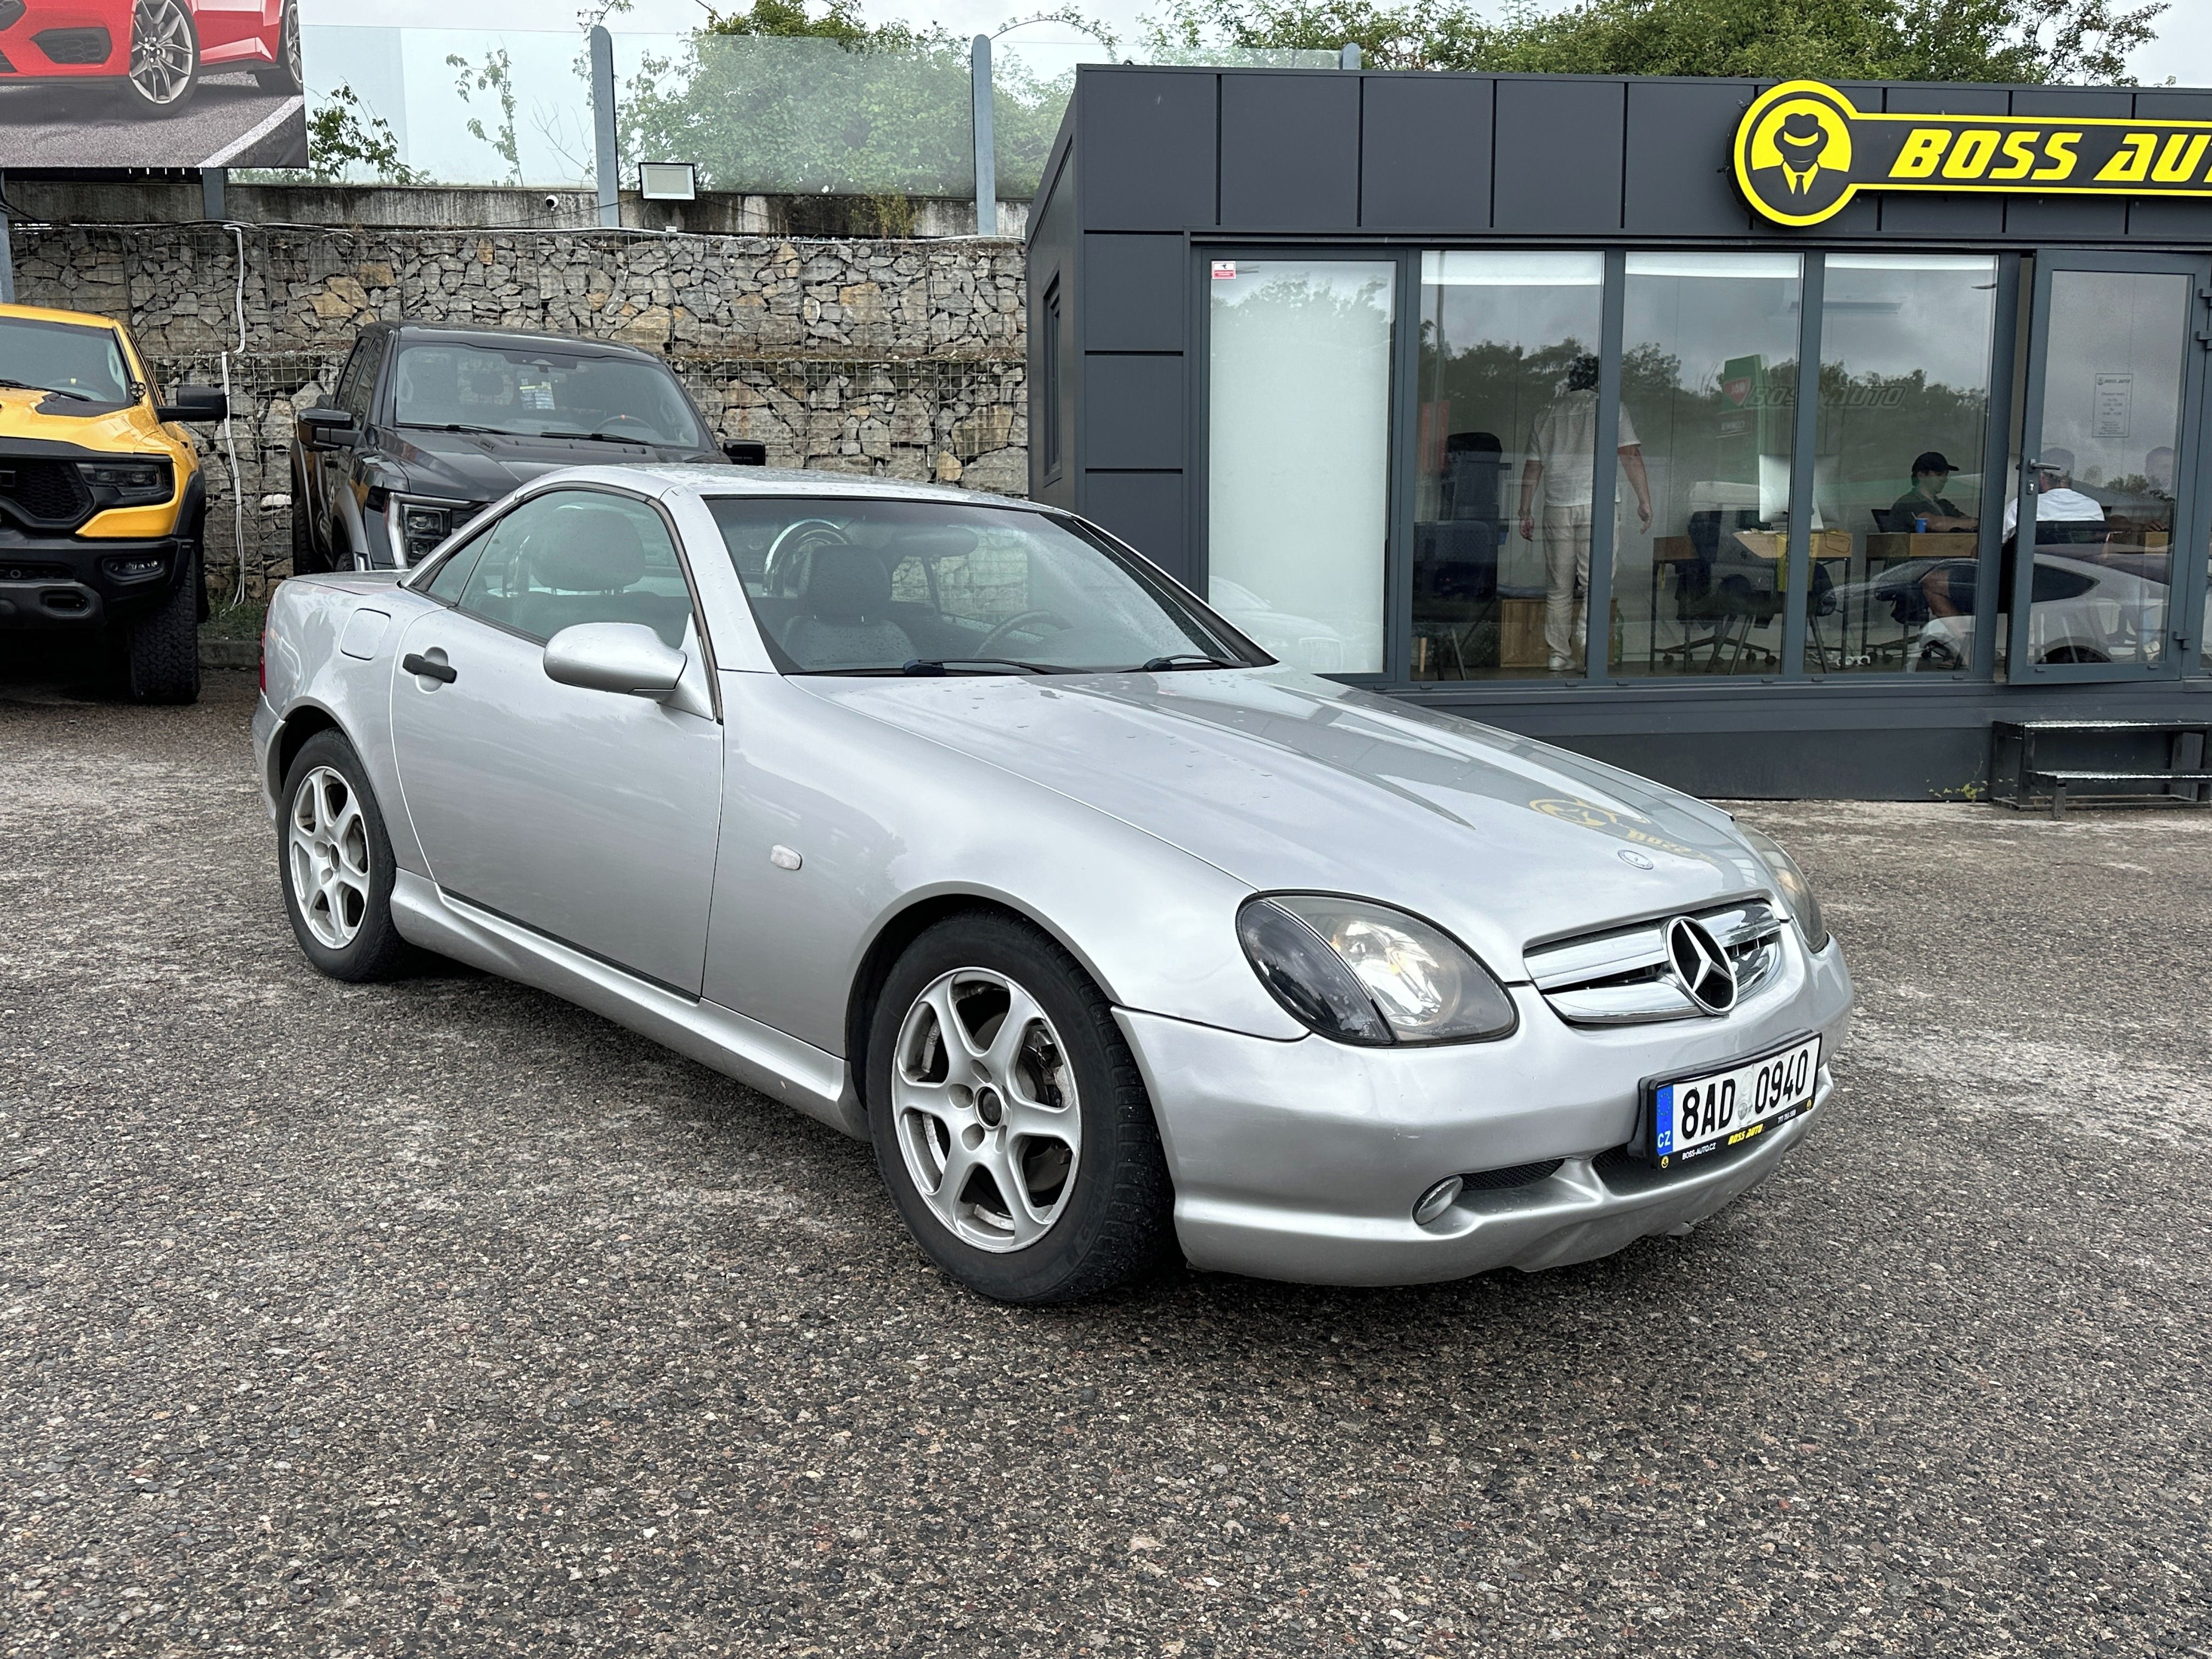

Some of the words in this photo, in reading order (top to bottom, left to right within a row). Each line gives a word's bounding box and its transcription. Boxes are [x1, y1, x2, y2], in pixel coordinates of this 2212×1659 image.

[1888, 128, 2083, 180] BOSS
[1825, 386, 1906, 406] AUTO
[1681, 1078, 1736, 1139] 8AD
[1755, 1049, 1809, 1114] 0940
[1658, 1130, 1671, 1148] CZ
[1728, 1131, 1746, 1145] BOSS
[1745, 1124, 1763, 1139] AUTO
[1682, 1142, 1716, 1160] BOSS-AUTO.CZ
